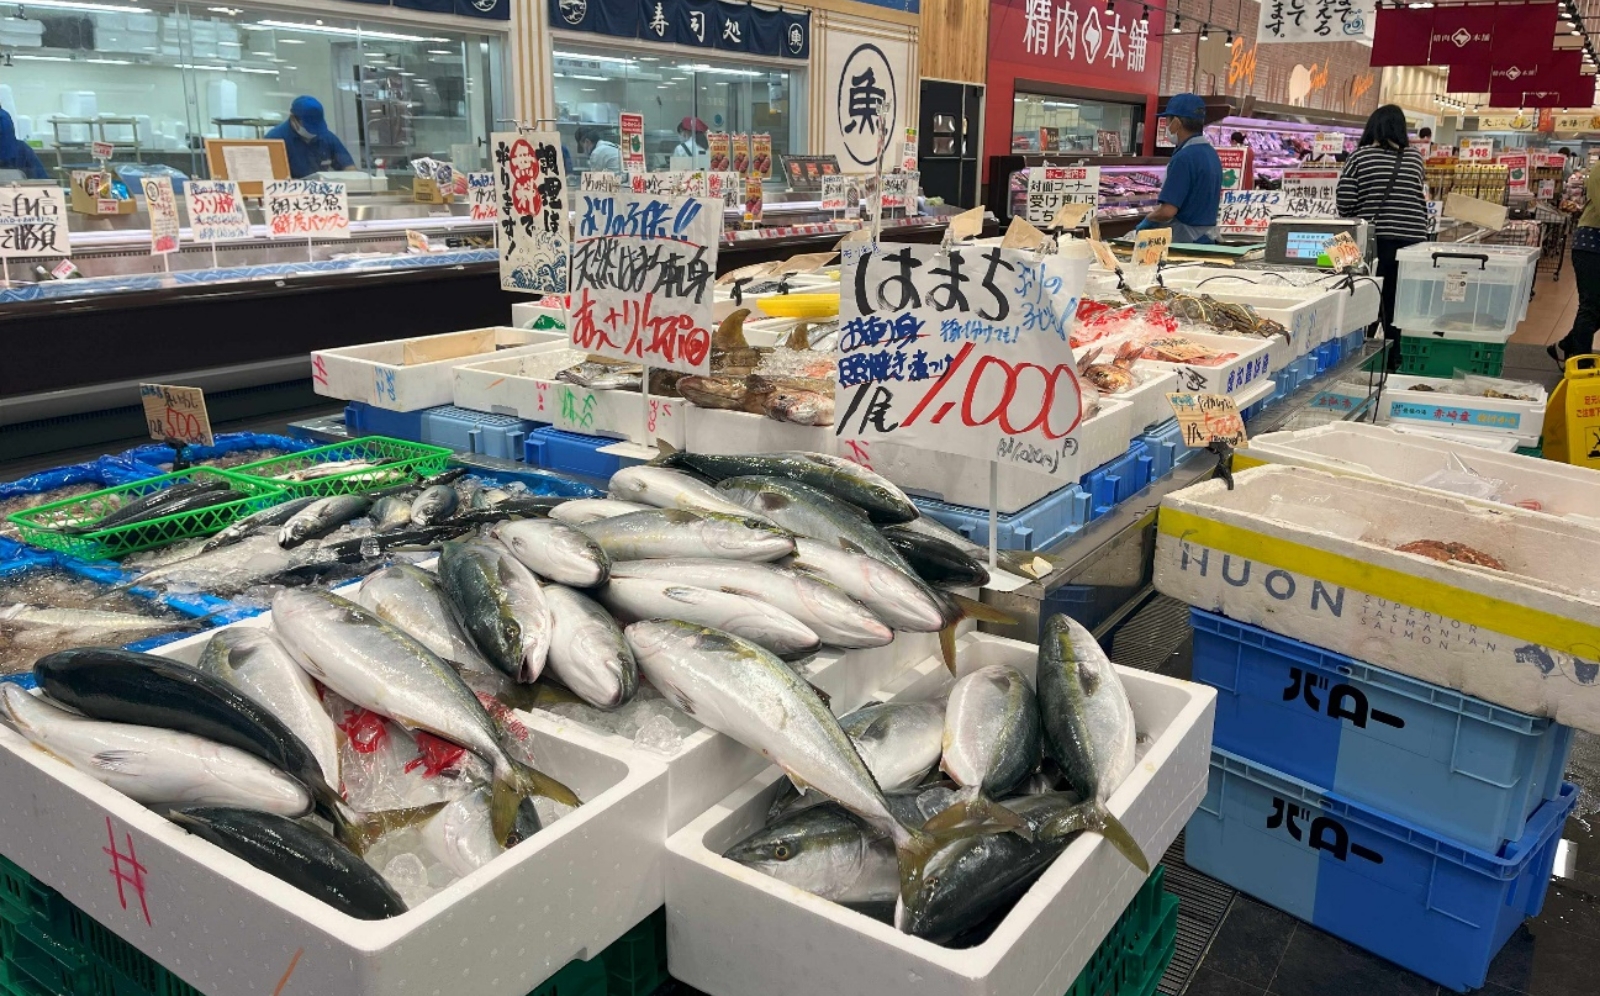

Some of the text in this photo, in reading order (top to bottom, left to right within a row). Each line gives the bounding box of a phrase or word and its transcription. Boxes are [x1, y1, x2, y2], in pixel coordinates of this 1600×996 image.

[650, 2, 741, 43] 寿司処
[1022, 0, 1079, 61] 精肉
[845, 66, 888, 136] 魚
[1469, 148, 1489, 158] 398
[513, 142, 537, 238] 無料で
[536, 142, 562, 234] 調理は
[1030, 180, 1093, 193] 対面コーナー
[855, 247, 1014, 322] はまち
[899, 342, 1083, 440] 1,000
[1584, 395, 1600, 406] 足元
[166, 408, 201, 438] 500
[1179, 543, 1346, 619] HUON
[1359, 617, 1451, 652] SALMON
[1361, 606, 1498, 654] TASMANIAN
[1363, 593, 1479, 635] SUPERIOR
[1283, 666, 1406, 730] バロー
[1266, 796, 1384, 865] バロー
